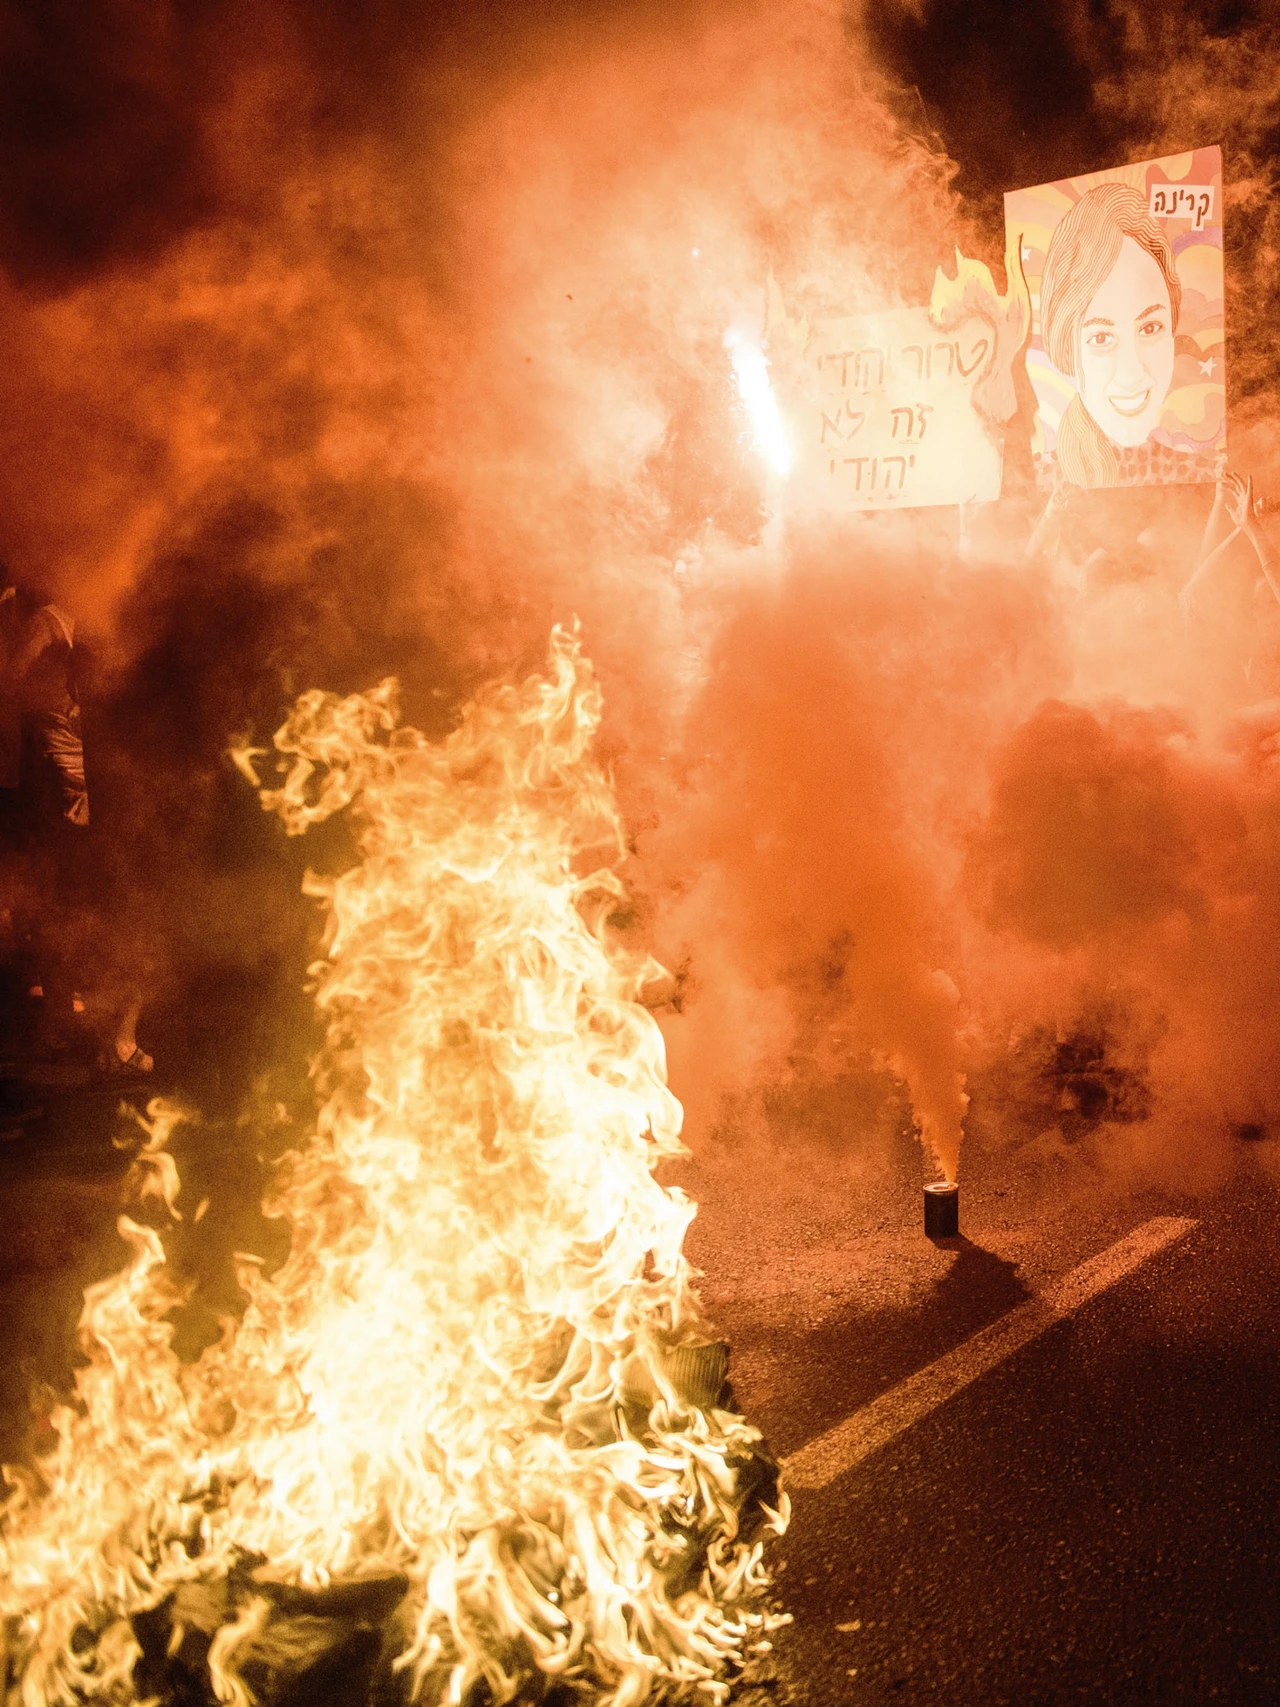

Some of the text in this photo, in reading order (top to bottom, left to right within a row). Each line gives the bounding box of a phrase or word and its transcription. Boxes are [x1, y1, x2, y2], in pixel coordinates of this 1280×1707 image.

[1154, 189, 1210, 227] קרינה
[902, 338, 989, 381] טרור
[820, 400, 934, 443] זה לא
[829, 454, 916, 491] יהודי
